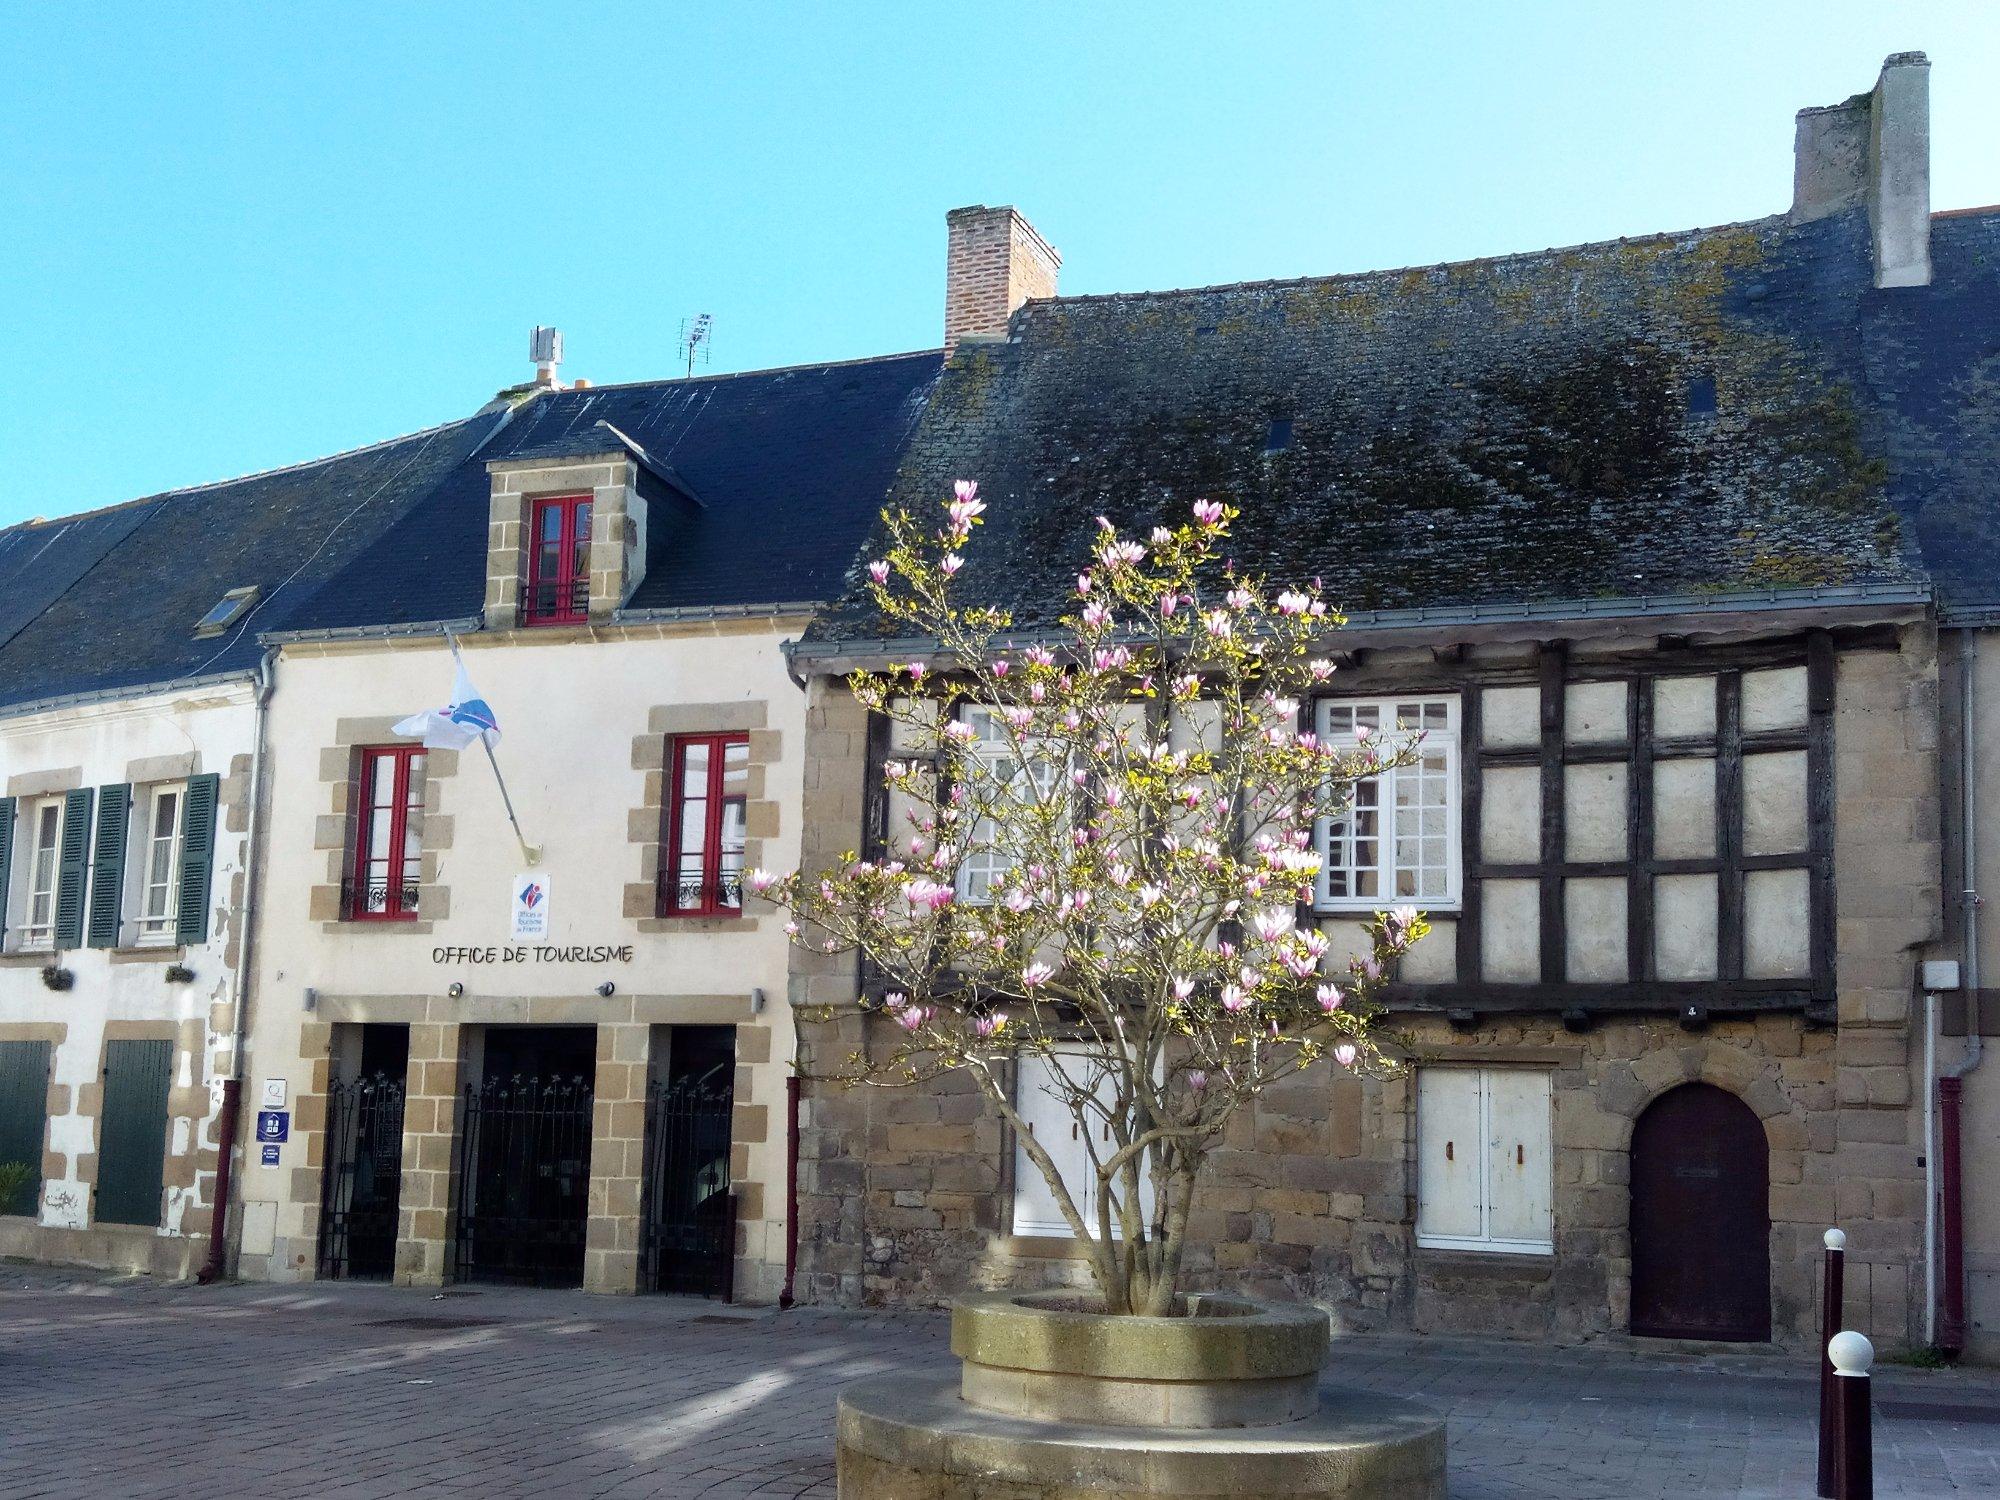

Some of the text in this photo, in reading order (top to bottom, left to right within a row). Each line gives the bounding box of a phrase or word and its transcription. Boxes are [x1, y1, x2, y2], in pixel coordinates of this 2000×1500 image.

[432, 945, 633, 963] OFFICE DE TOURISME
